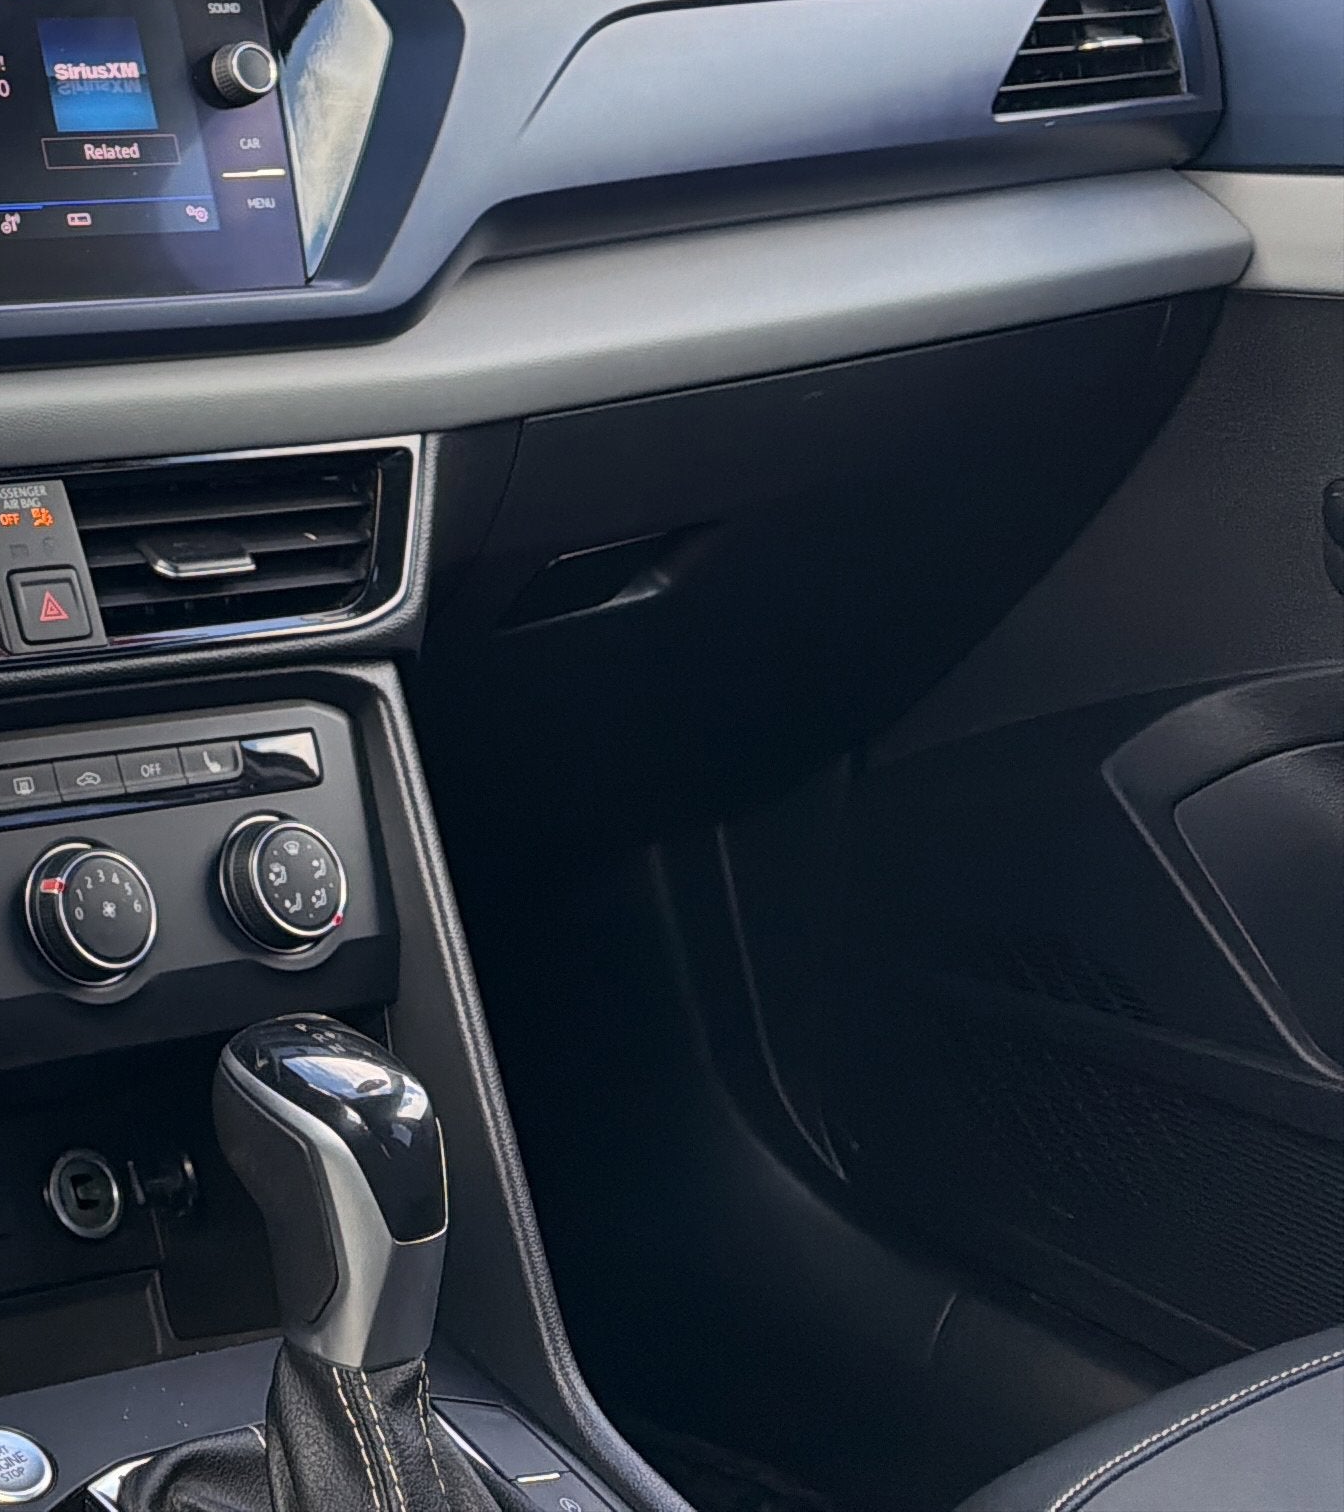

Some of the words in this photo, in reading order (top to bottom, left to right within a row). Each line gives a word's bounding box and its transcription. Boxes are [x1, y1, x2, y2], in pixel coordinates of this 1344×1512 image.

[207, 2, 241, 14] SOUND
[53, 62, 140, 80] SiriusXM
[239, 137, 261, 150] CAR
[84, 143, 141, 161] Related
[246, 197, 276, 209] MENU
[3, 498, 19, 510] AIR
[20, 497, 42, 508] BAG
[0, 512, 21, 526] OFF
[140, 763, 161, 778] OFF
[84, 876, 93, 889] 2
[96, 869, 105, 883] 3
[111, 872, 120, 885] 4
[75, 889, 84, 902] 1
[124, 882, 132, 896] 5
[133, 899, 142, 913] 6
[74, 906, 84, 921] 0
[0, 1466, 25, 1482] STOP
